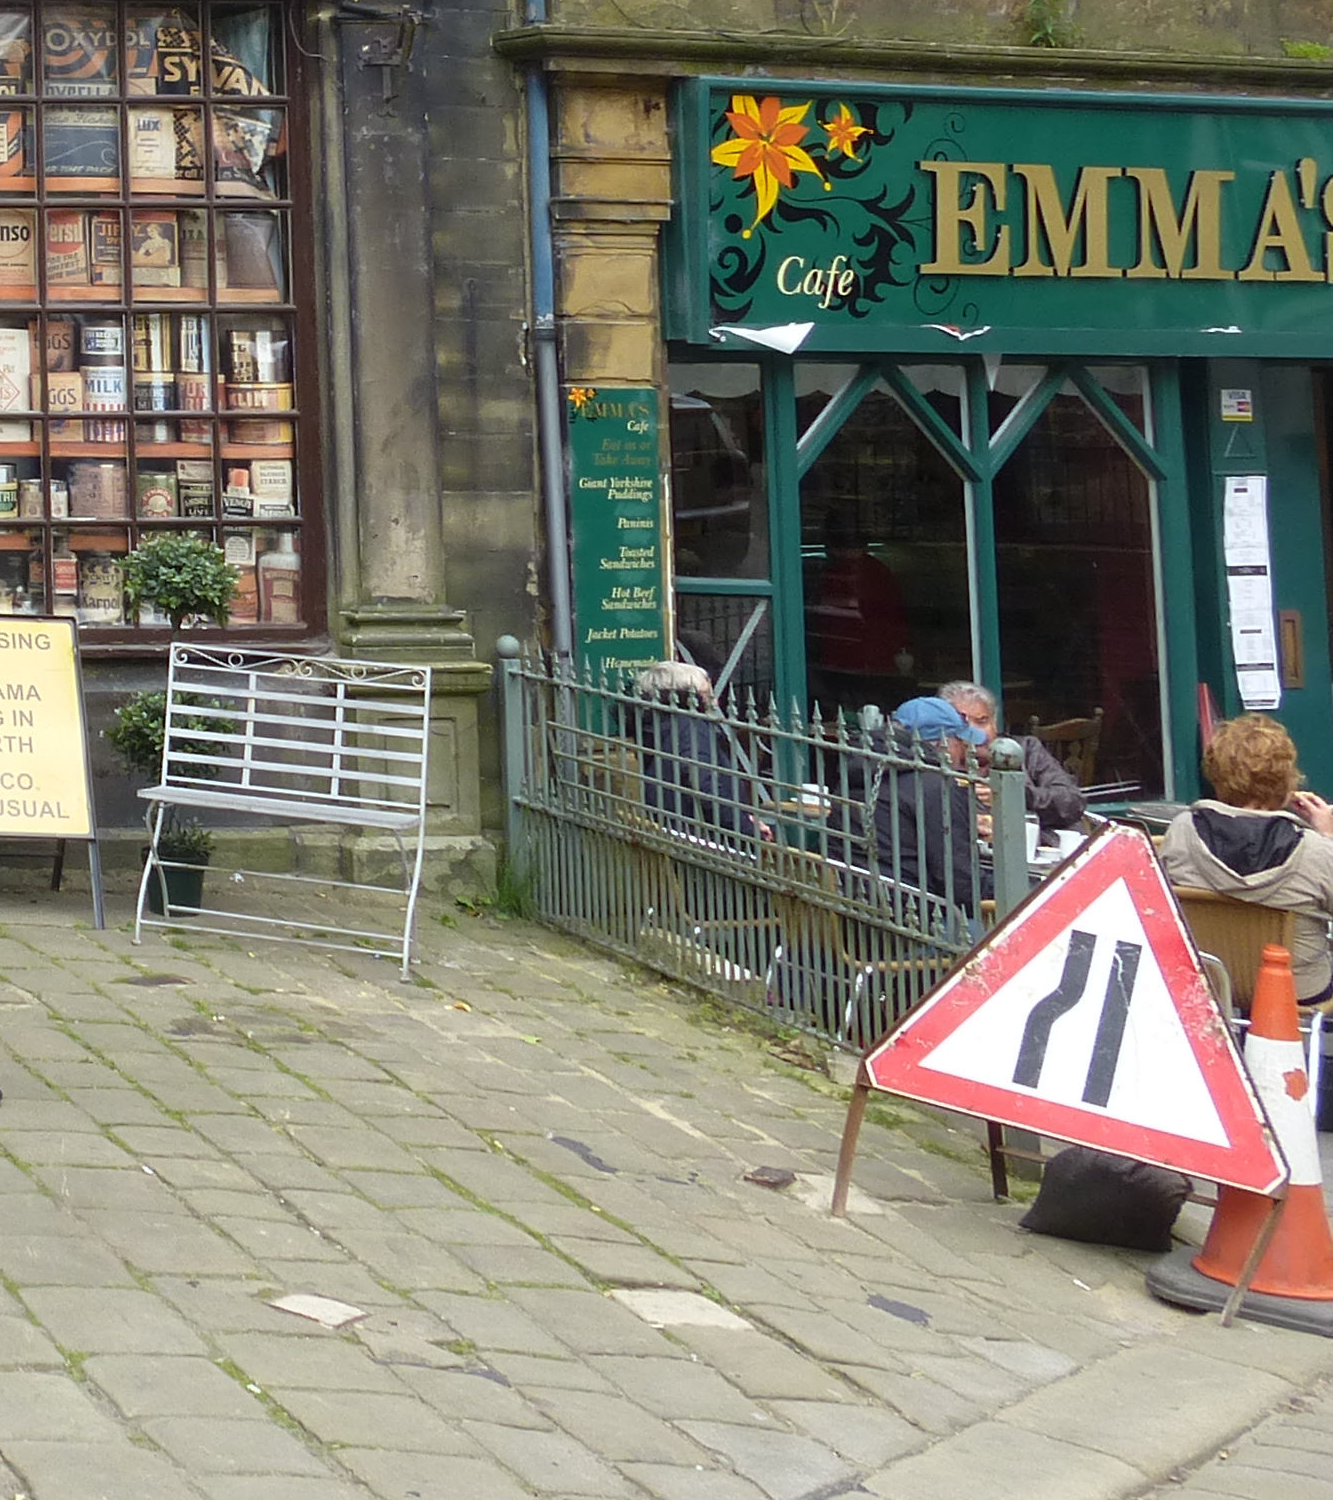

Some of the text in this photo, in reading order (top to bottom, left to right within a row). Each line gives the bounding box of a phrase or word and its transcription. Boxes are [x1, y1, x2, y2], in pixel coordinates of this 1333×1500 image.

[164, 56, 270, 96] SYVAN
[137, 118, 161, 131] LUX
[46, 165, 82, 174] AR-TIME
[918, 158, 1333, 282] EMMA'
[49, 222, 83, 242] ersil
[99, 223, 145, 236] JIFY
[776, 255, 855, 309] Cafe
[85, 380, 122, 393] MILK
[48, 388, 77, 405] GGS
[627, 420, 649, 435] Cafe
[579, 477, 653, 489] Giant Yorkshire
[608, 488, 653, 501] Puddings
[617, 518, 654, 528] Paninis
[619, 547, 654, 558] Toasted
[599, 558, 655, 570] Sandwiches
[611, 587, 655, 600] Hot Beef
[601, 598, 657, 610] Sandwiches
[585, 628, 658, 643] Jacket Potatoes
[13, 710, 33, 726] IN
[0, 773, 40, 791] CO.
